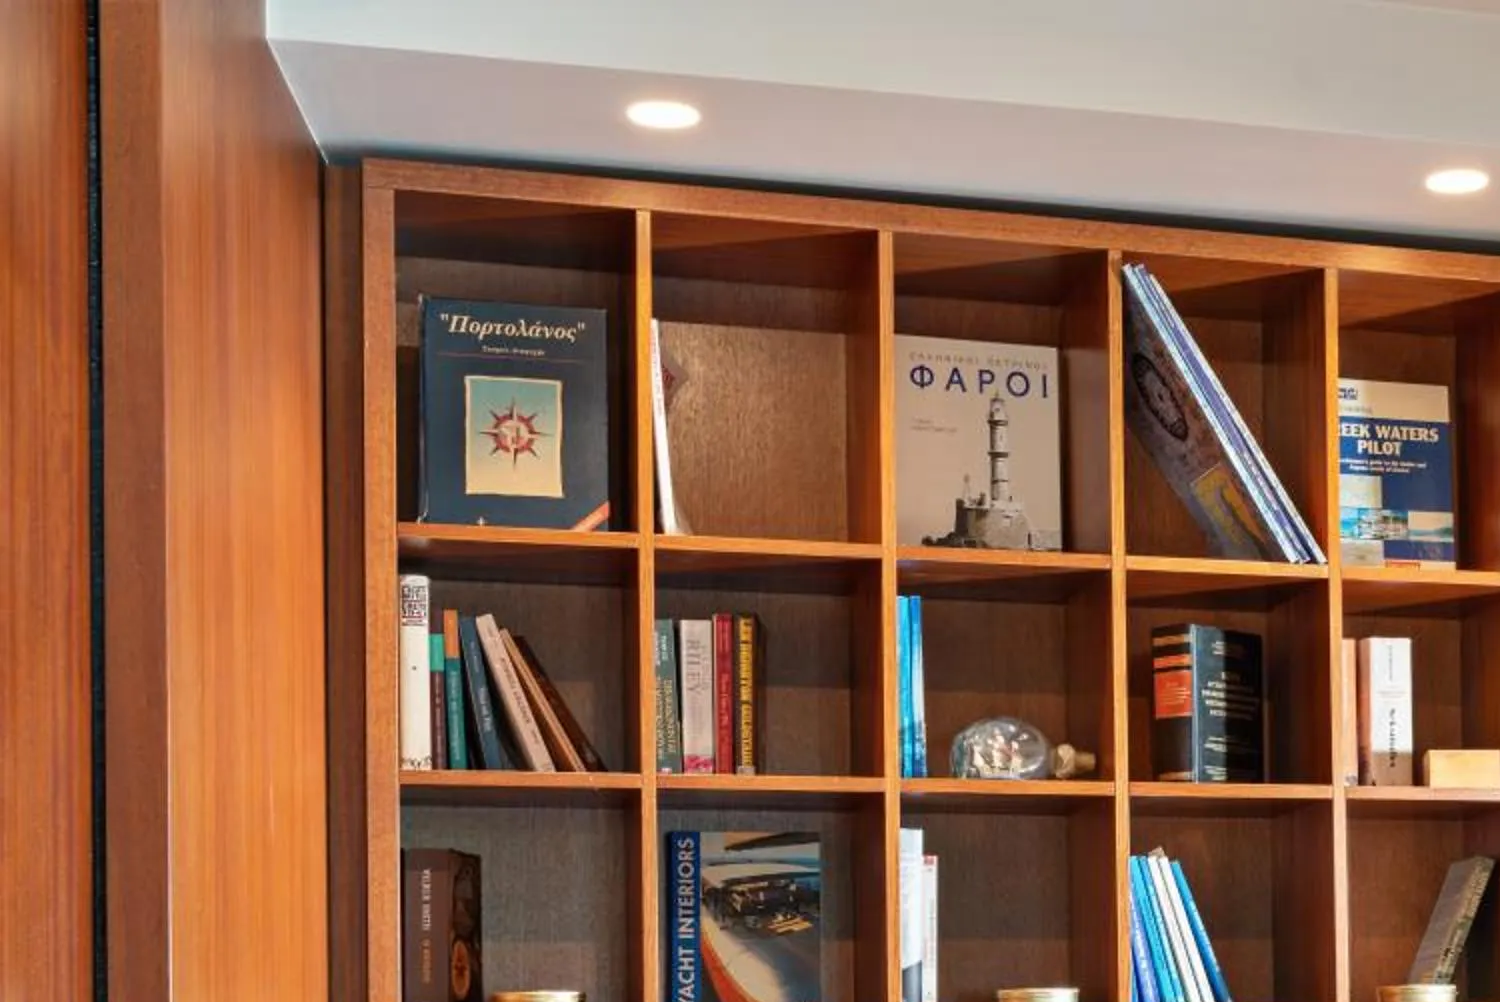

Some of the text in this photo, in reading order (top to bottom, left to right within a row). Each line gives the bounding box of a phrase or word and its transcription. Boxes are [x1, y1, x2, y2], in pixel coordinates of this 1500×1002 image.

[909, 363, 1049, 399] ΦΑΡΟΙ
[1339, 422, 1440, 443] EEK WATERS
[1356, 440, 1403, 456] PILOT
[685, 639, 702, 696] RILEY
[676, 836, 695, 941] INTERIORS
